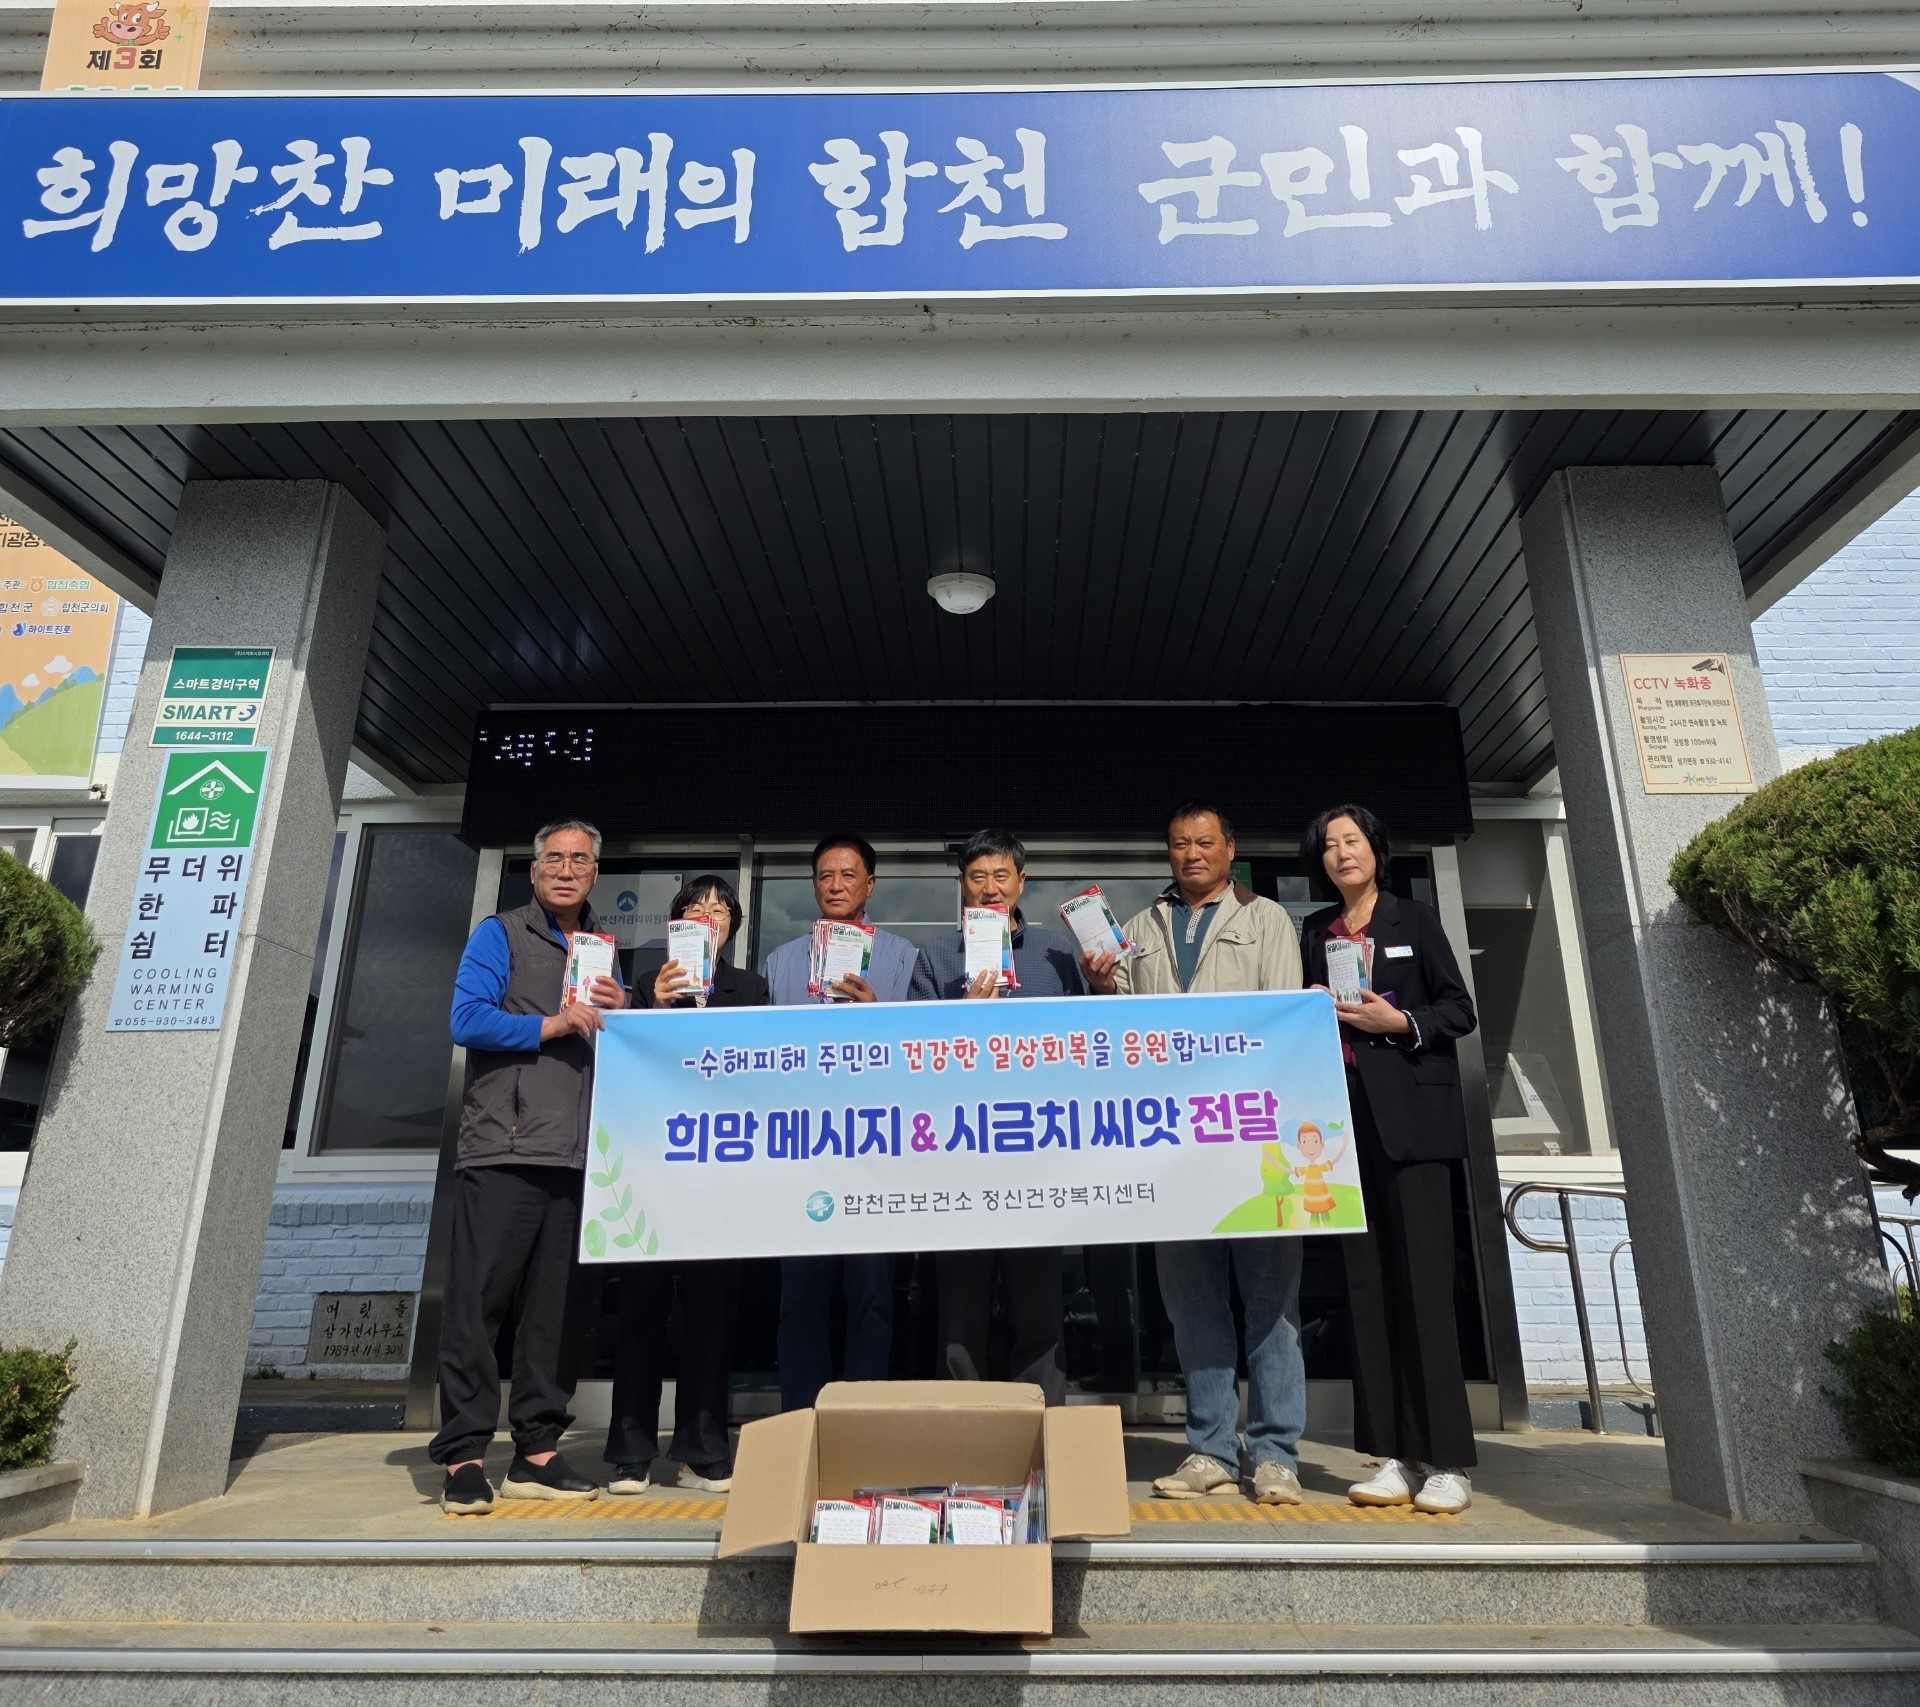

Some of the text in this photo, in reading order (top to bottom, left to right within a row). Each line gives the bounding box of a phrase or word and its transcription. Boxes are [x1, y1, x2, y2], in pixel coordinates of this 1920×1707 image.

[86, 47, 163, 70] 제3회
[24, 120, 1868, 256] 희망찬 미래의 합천 군민과 함께!
[62, 602, 109, 614] 합천군의회
[28, 624, 71, 635] 하이트진로
[173, 677, 260, 691] 스마트경비구역
[1633, 676, 1712, 690] CCTV 녹화중
[163, 704, 236, 721] SMART
[175, 731, 234, 742] 1644-3112
[145, 854, 243, 883] 무더위
[138, 892, 237, 921] 한파
[130, 930, 229, 959] 쉼터
[133, 967, 217, 980] COOLING
[131, 983, 214, 995] WARMING
[133, 998, 205, 1010] CENTER
[818, 1043, 890, 1075] 주민의
[902, 1037, 977, 1071] 건강한
[989, 1032, 1111, 1069] 일상회복을
[664, 1090, 1280, 1163] 희망 메시지 & 시금치 씨앗 전달
[843, 1182, 1156, 1215] 합천군보건소 정신건강복지센터
